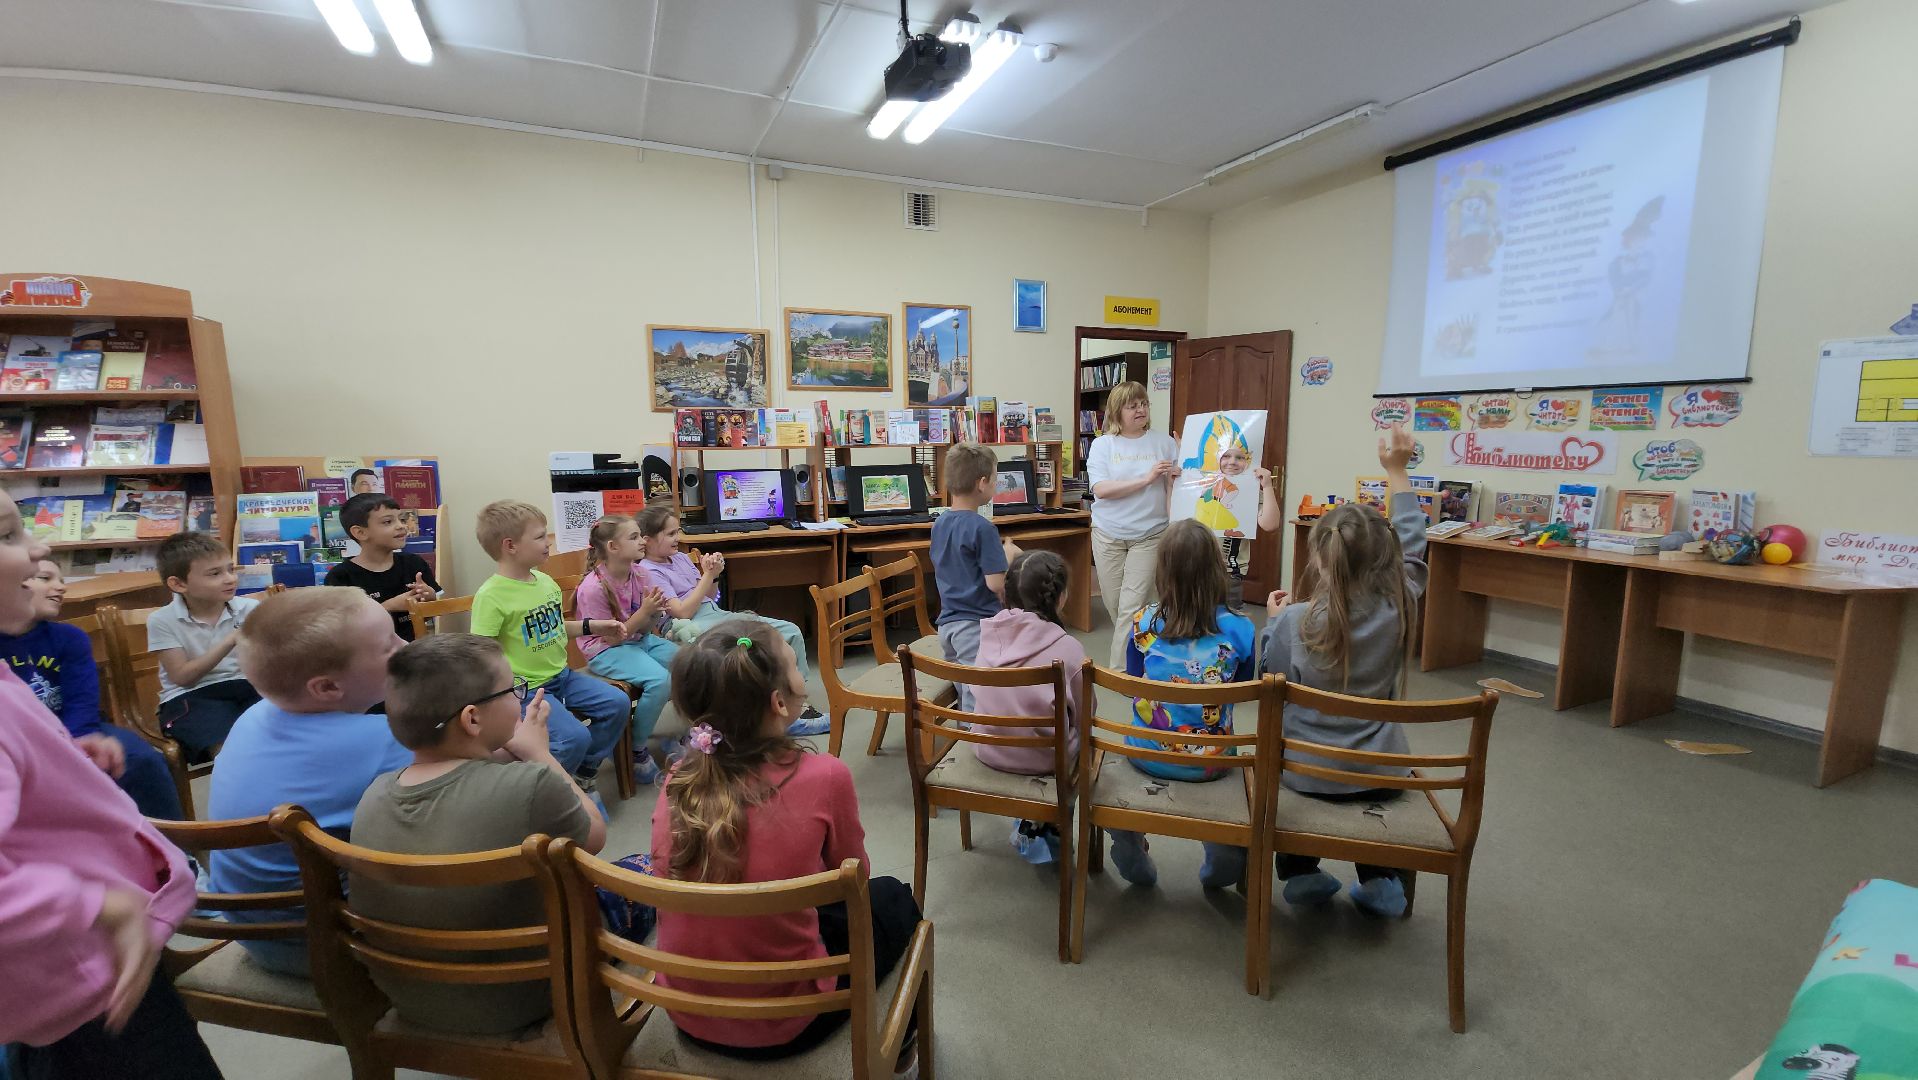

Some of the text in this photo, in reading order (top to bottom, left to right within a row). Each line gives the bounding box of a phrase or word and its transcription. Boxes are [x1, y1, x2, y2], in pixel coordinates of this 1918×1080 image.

[1113, 305, 1152, 316] АБОНЕМЕНТ
[1603, 394, 1649, 404] ЛЕТНЕЕ
[1686, 391, 1698, 405] Я
[1539, 399, 1550, 411] Я
[1602, 407, 1648, 417] ЧТЕНИЕ
